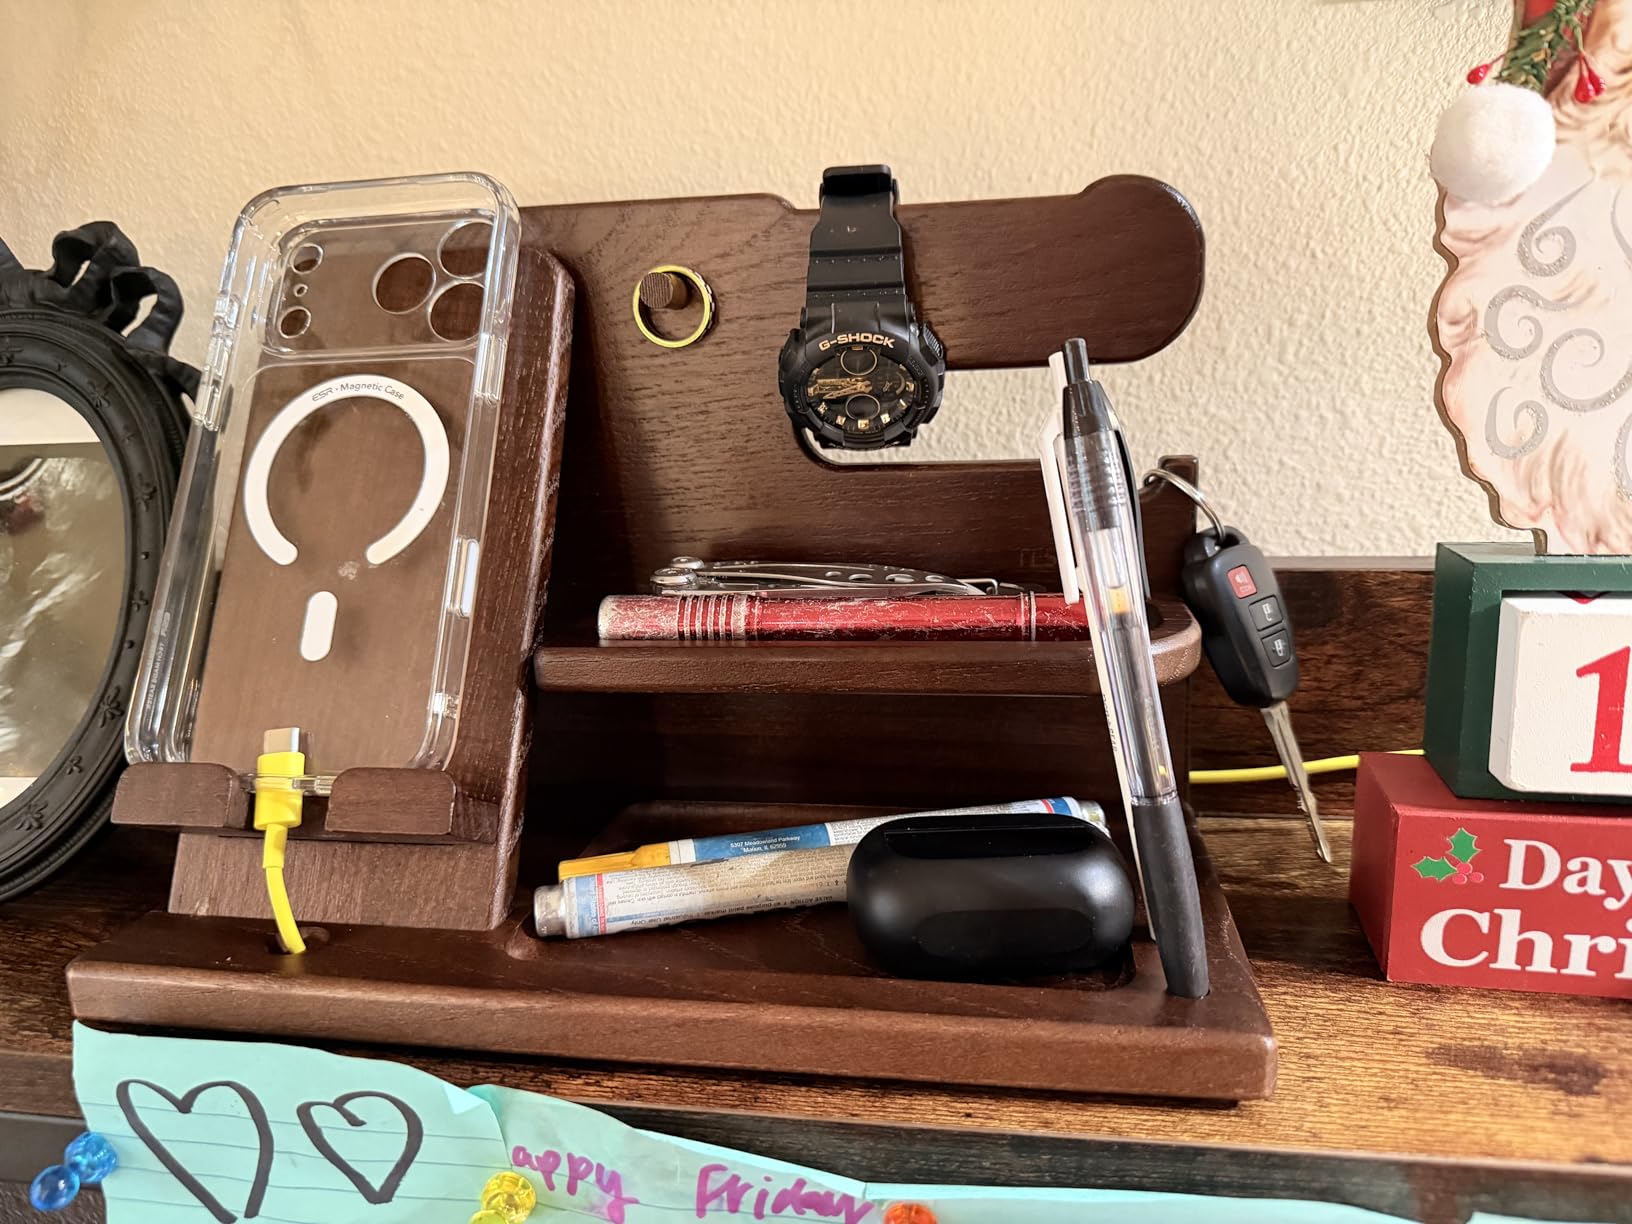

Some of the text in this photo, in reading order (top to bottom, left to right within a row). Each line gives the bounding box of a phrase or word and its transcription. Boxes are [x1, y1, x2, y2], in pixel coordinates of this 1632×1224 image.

[819, 333, 896, 351] G-SHOCK
[312, 383, 404, 401] ESR Magnetic Case
[1570, 646, 1632, 772] 1
[1499, 838, 1632, 910] Day
[511, 1145, 876, 1224] appy Friday
